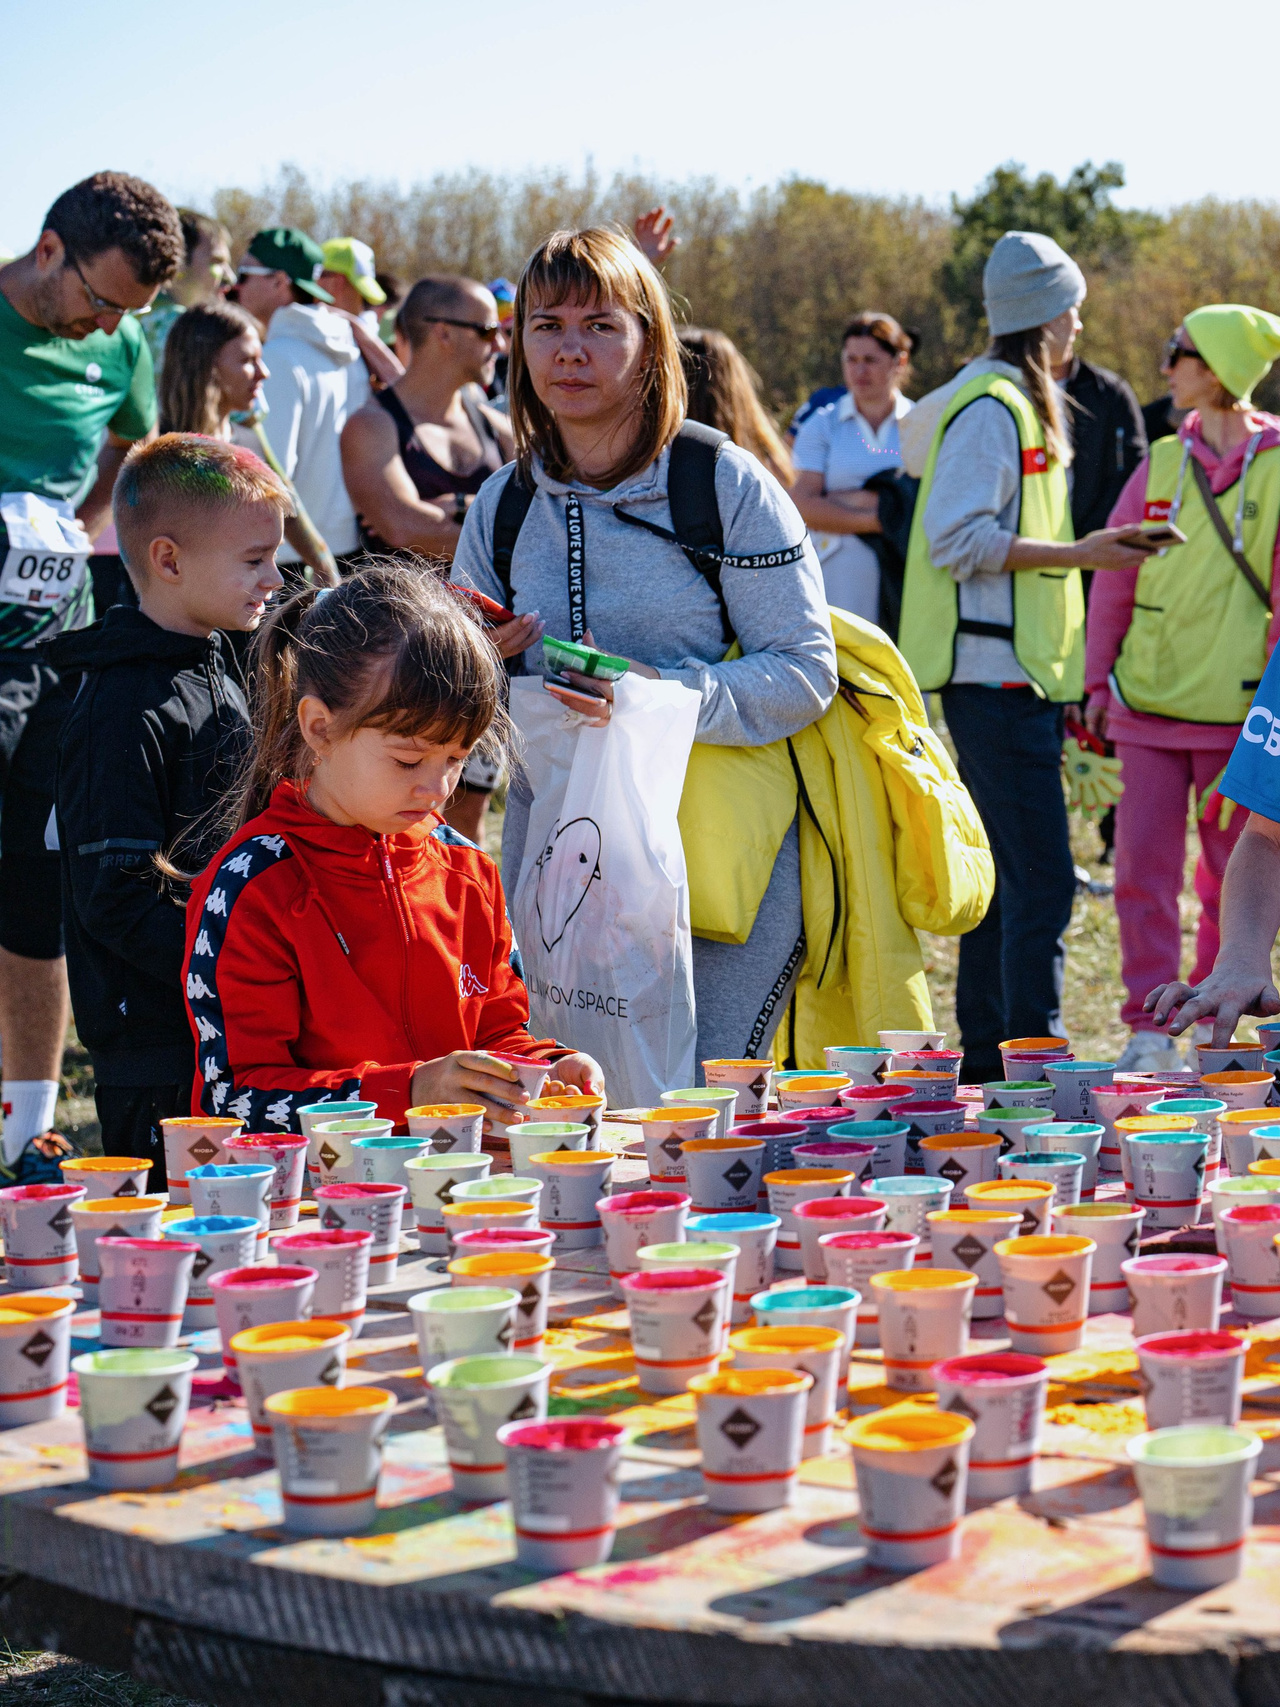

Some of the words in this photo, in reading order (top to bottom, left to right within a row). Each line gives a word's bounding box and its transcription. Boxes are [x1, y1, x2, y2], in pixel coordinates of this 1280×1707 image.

[569, 519, 582, 548] LOVE
[18, 555, 74, 581] 068
[753, 553, 782, 567] LOVE
[570, 562, 582, 592] LOVE
[572, 606, 584, 637] LOVE
